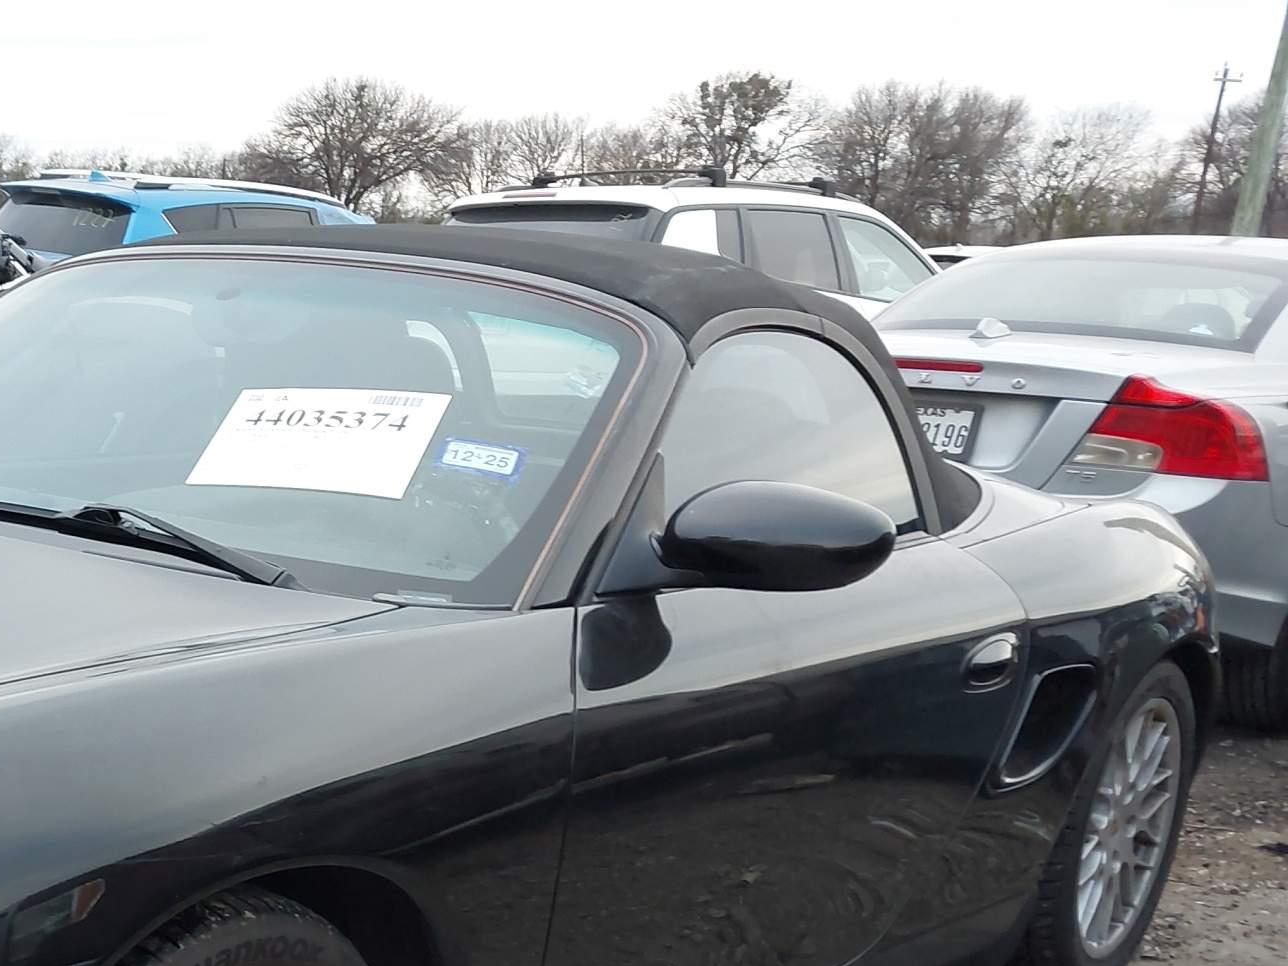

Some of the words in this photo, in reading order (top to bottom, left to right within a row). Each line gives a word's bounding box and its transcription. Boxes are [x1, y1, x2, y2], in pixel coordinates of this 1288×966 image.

[918, 372, 1027, 390] LVO
[244, 408, 409, 433] 44035374
[915, 406, 947, 418] EXAS
